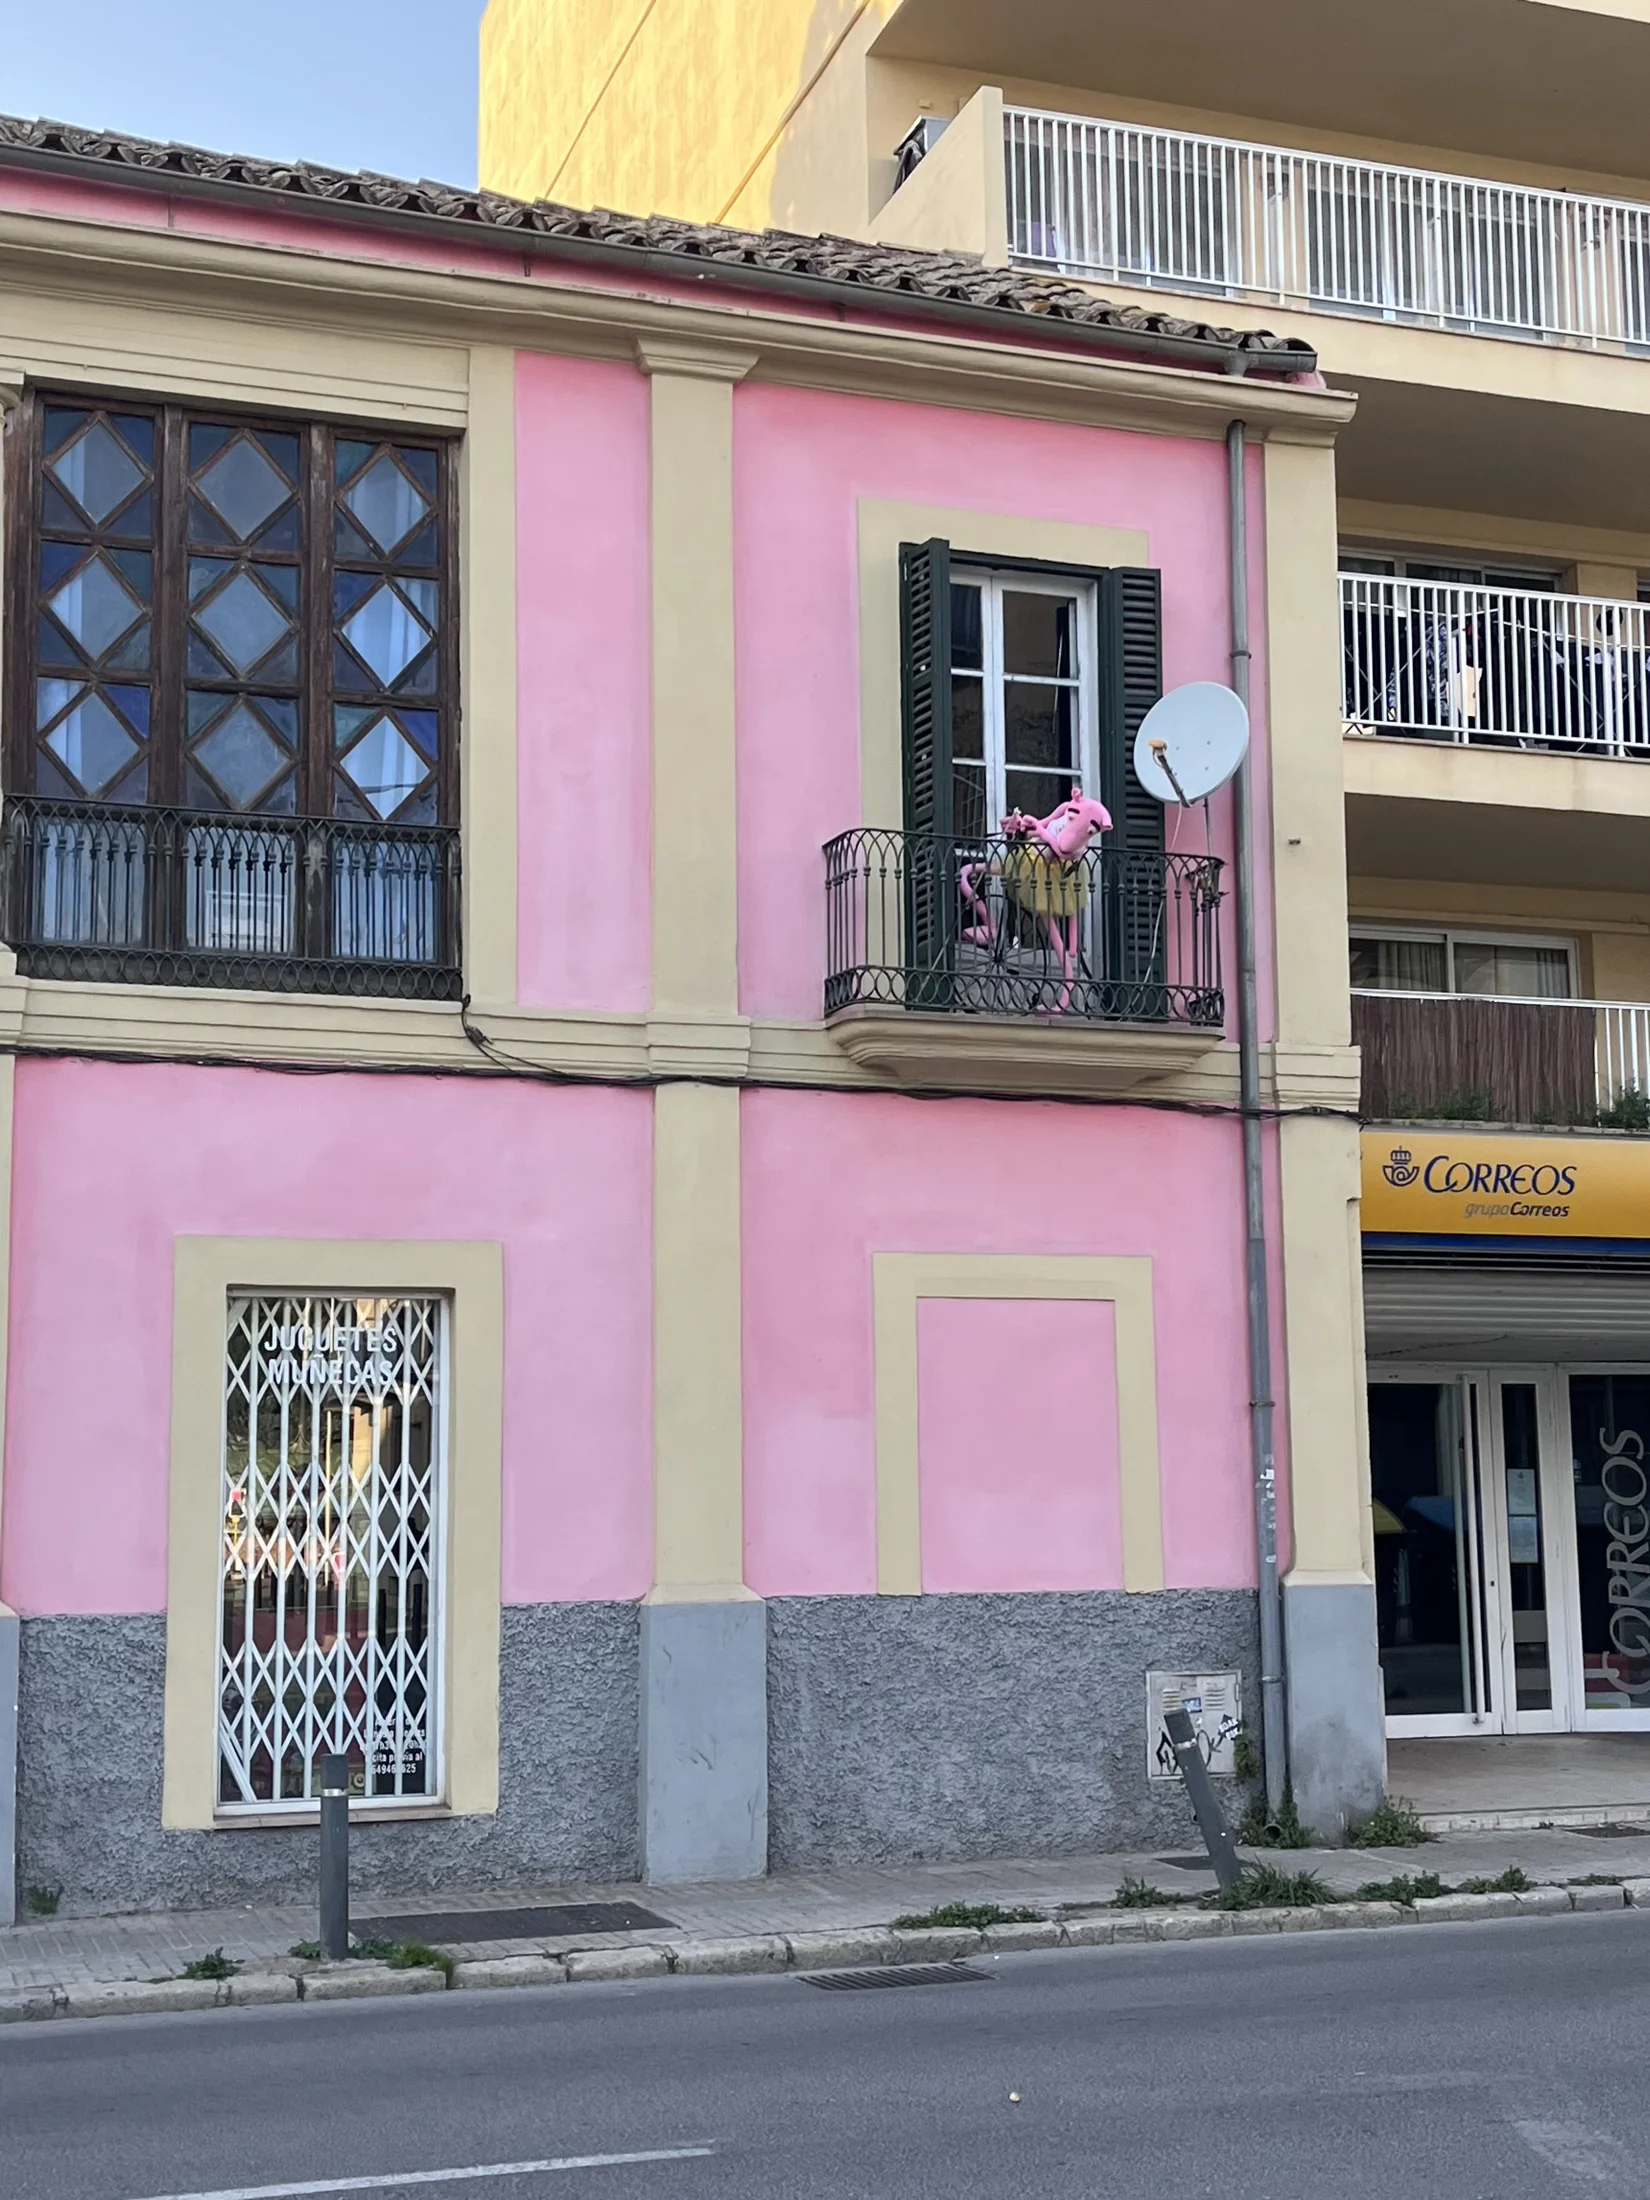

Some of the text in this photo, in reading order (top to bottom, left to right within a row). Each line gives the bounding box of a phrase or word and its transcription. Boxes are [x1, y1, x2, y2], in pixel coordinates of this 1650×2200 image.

[1423, 1155, 1577, 1196] CORREOS
[264, 1326, 397, 1352] JUGUETES
[268, 1353, 393, 1385] MUÑECAS
[415, 1752, 423, 1761] al
